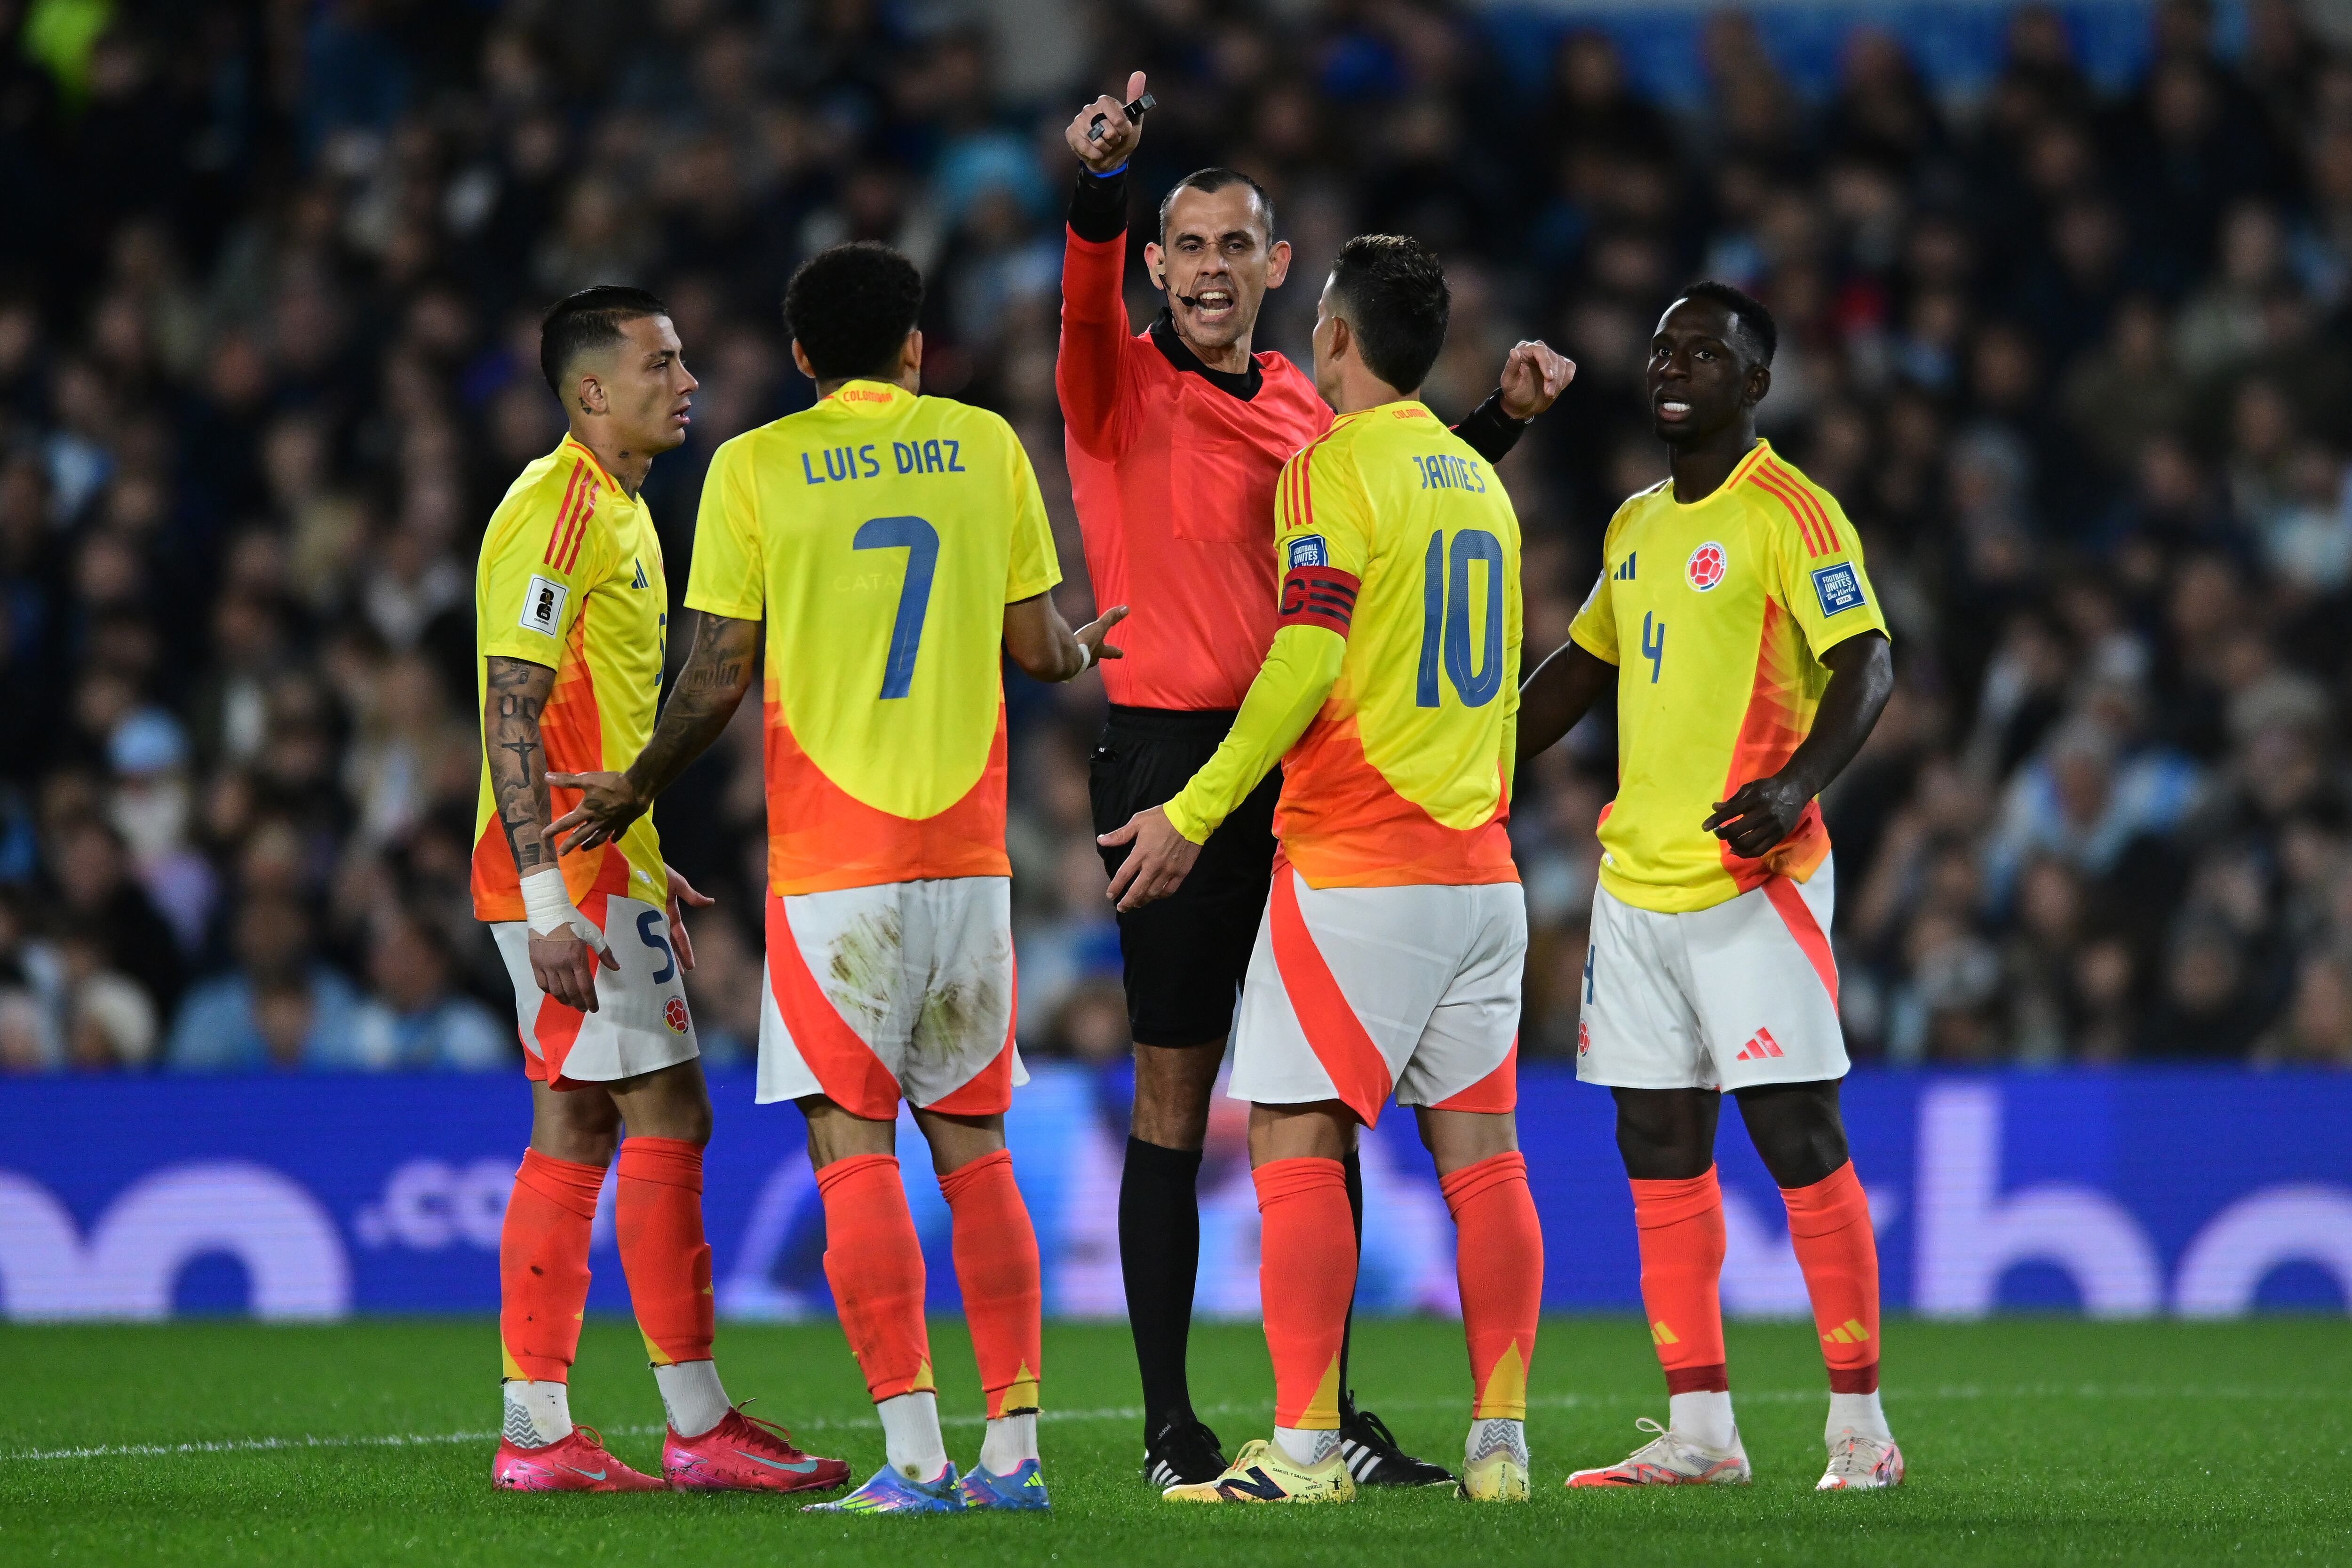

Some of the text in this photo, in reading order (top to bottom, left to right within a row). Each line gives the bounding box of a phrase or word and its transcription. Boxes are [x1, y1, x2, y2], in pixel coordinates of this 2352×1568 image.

[802, 439, 966, 485] LUIS DIAZ
[1412, 454, 1486, 494] JAMES
[1294, 543, 1318, 556] FOOTBALL
[1294, 550, 1318, 565] UNITES
[1822, 570, 1849, 584] FOOTBALL
[1824, 577, 1852, 593] UNITES
[1826, 583, 1856, 601] the World
[852, 515, 940, 700] 7
[1416, 529, 1503, 708] 10
[1641, 610, 1665, 684] 4
[636, 909, 675, 985] 5
[1272, 1467, 1289, 1476] SAMUEL
